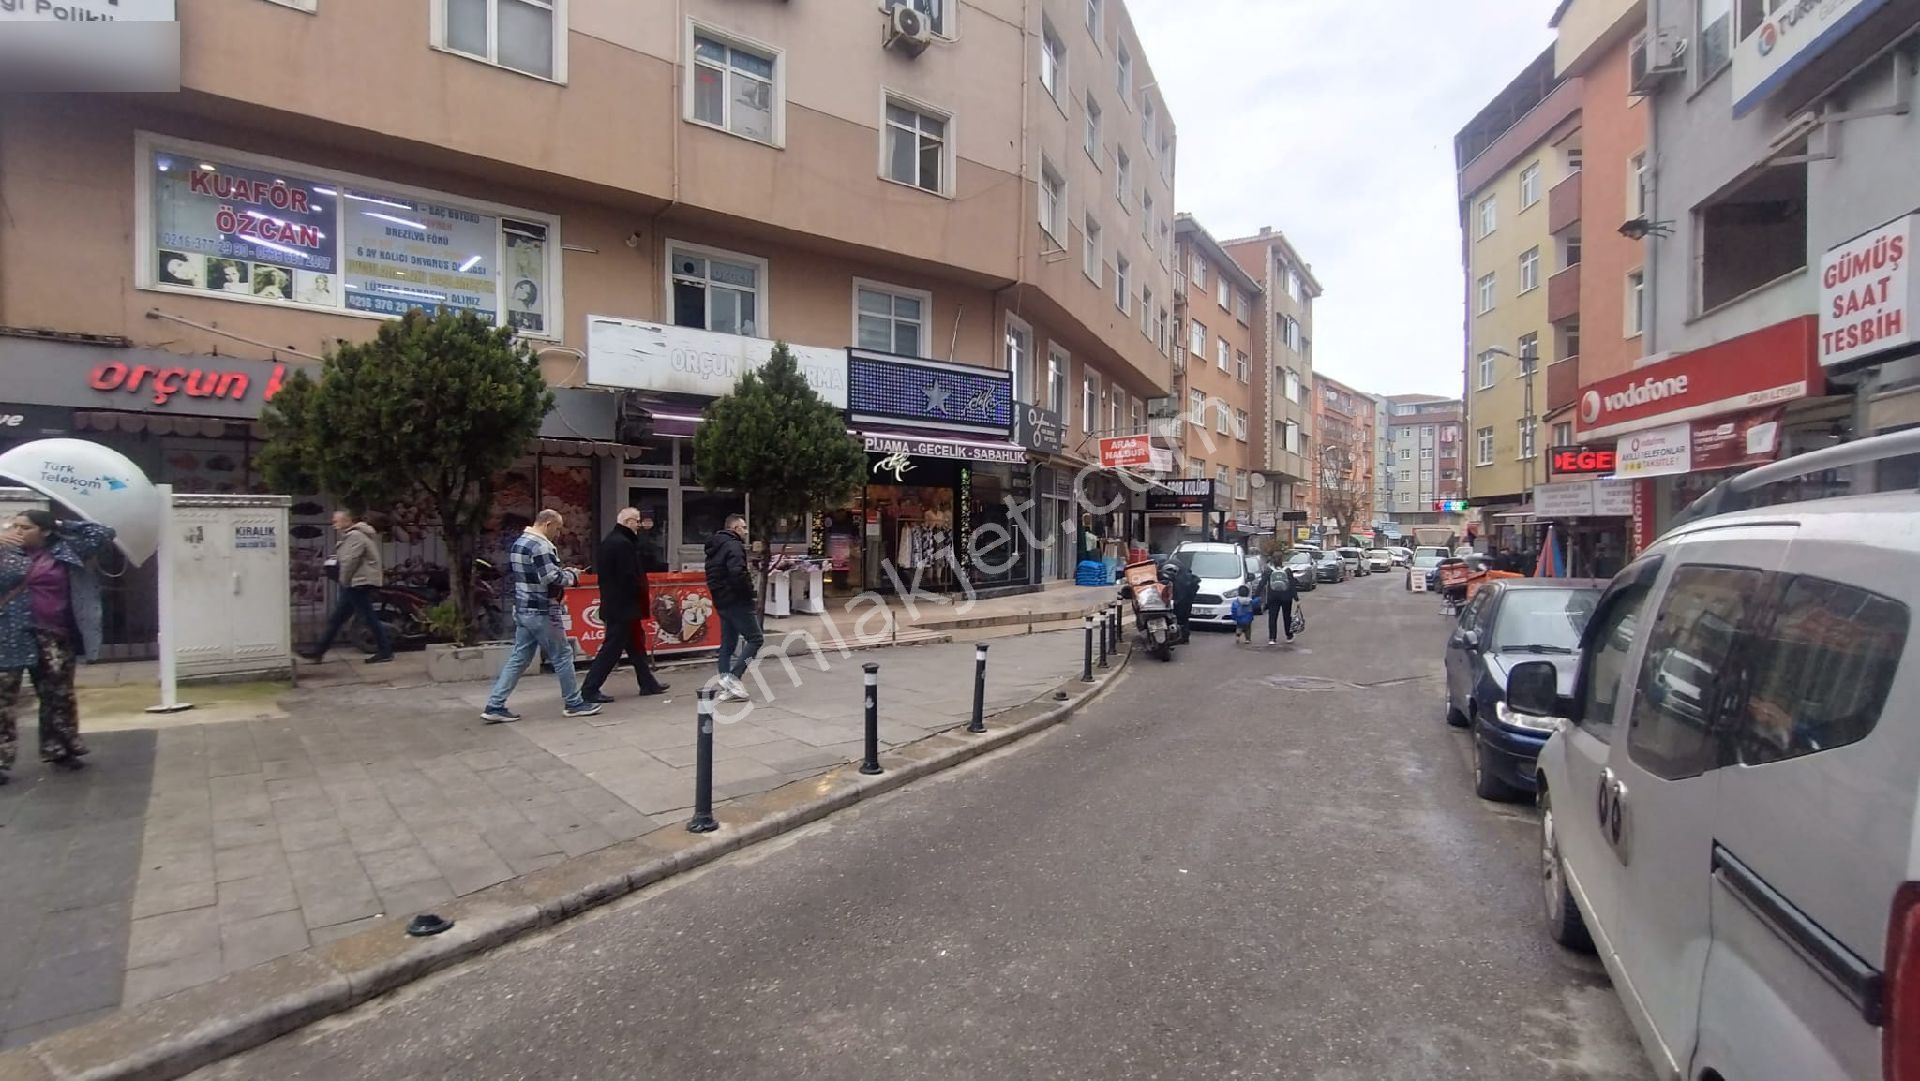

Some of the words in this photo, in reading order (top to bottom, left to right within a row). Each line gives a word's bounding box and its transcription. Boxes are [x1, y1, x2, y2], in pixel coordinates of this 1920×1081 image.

[216, 205, 320, 248] ÖZCAN
[1823, 235, 1904, 289] GÜMÜŞ
[1832, 276, 1891, 319] SAAT
[1822, 308, 1902, 355] TESBİH
[88, 361, 249, 405] orçun
[1603, 375, 1688, 412] vodafone
[1110, 439, 1137, 450] ARAS
[41, 472, 102, 489] Telekom
